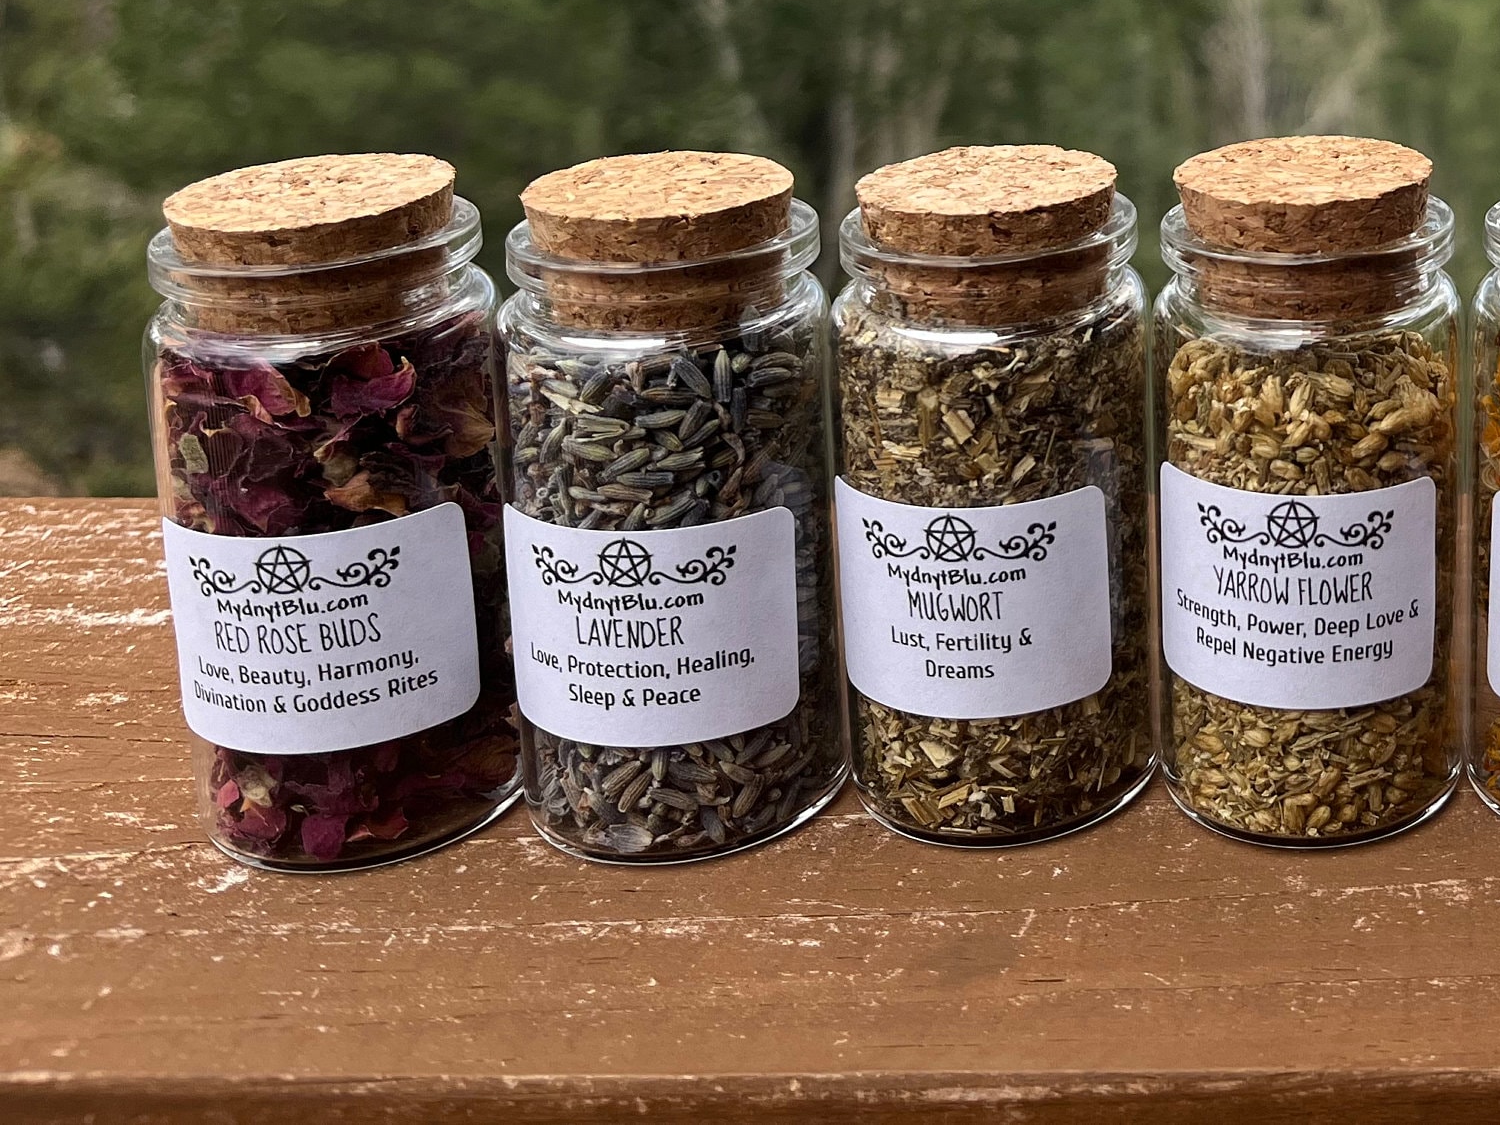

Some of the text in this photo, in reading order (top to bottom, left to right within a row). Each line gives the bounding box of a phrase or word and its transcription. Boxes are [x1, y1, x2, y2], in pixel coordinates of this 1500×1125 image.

[1223, 545, 1363, 573] MydnytBlu.com
[887, 563, 1026, 590] MydnytBlu.com
[1212, 564, 1373, 605] YARROW FLOWER
[217, 593, 368, 622] MydnytBlu.com
[558, 589, 704, 616] MydnytBlu.com
[907, 588, 1003, 621] MUGWORT
[1177, 588, 1419, 638] Strength, Power, Deep Love &
[215, 612, 382, 655] RED ROSE BUDS
[576, 615, 685, 649] LAVENDER
[891, 625, 1033, 653] Lust, Fertility &
[1197, 627, 1393, 667] Repel Negative Energy
[198, 649, 419, 688] Love, Beauty, Harmony,
[530, 641, 755, 679] Love, Protection, Healing,
[926, 660, 995, 679] Dreams
[194, 670, 438, 713] Divination & Goddess Rites
[569, 684, 701, 710] Sleep & Peace
